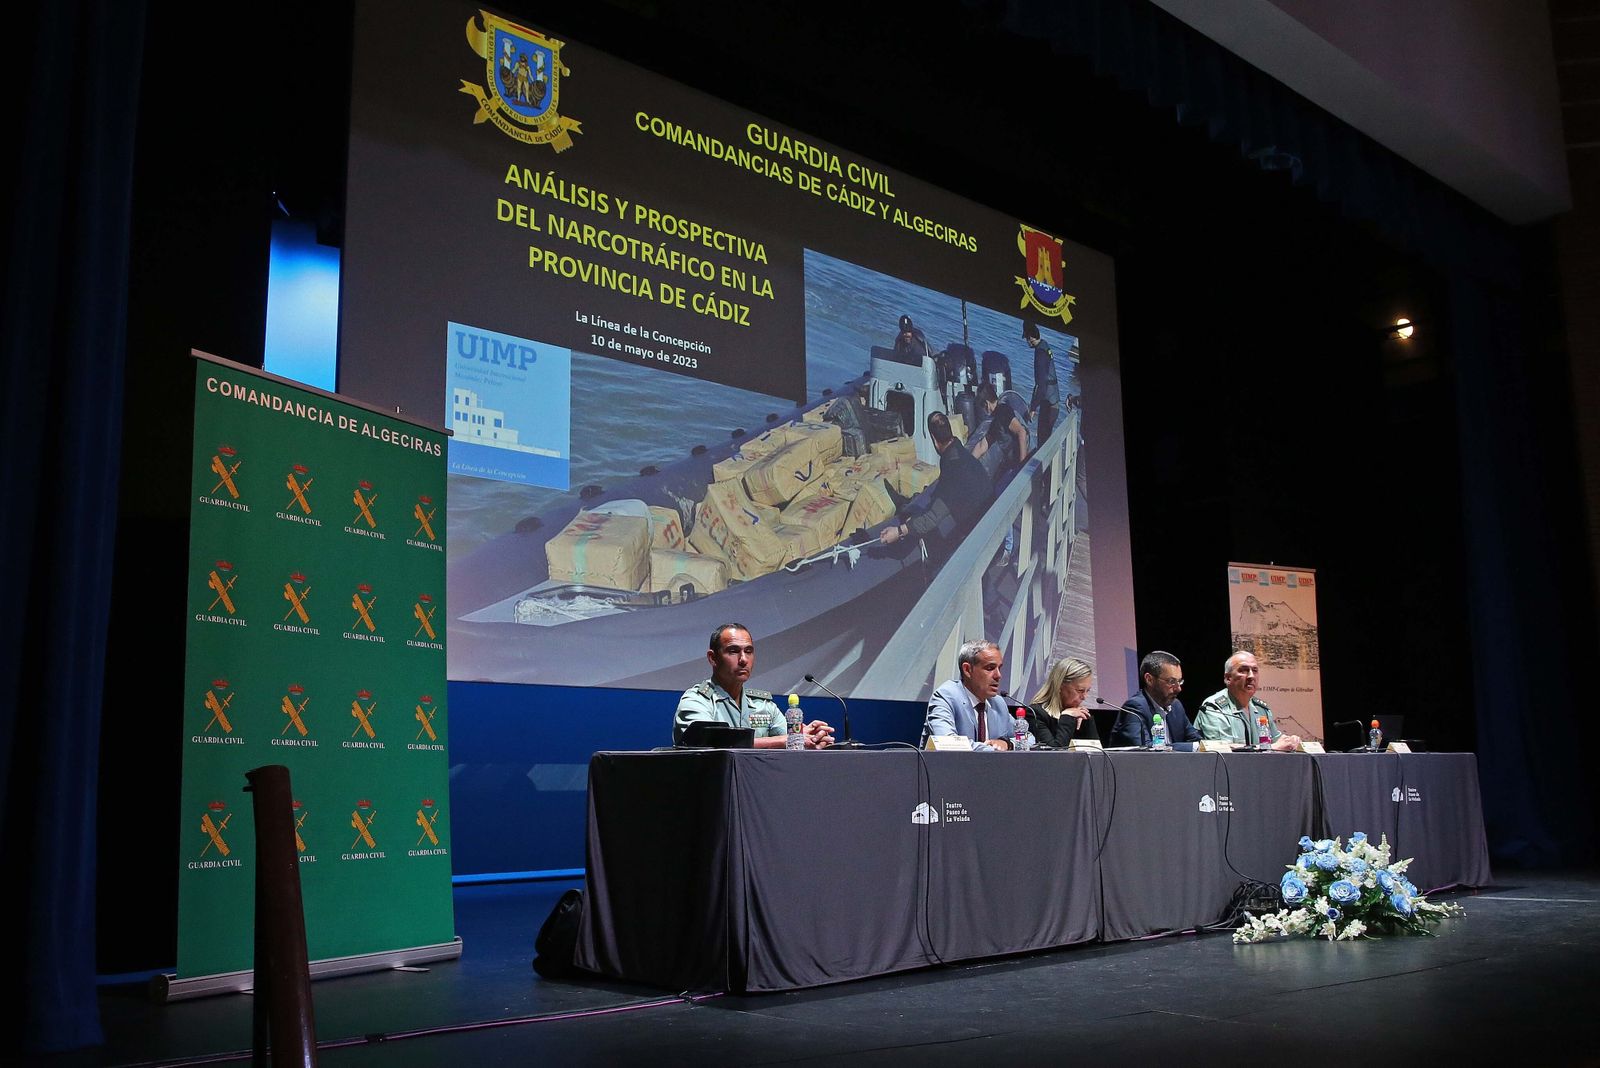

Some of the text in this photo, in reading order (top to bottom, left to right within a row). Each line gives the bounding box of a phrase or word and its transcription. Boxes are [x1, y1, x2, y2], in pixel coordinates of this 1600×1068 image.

[481, 98, 533, 142] COMANDANCIA
[747, 123, 896, 198] GUARDIA CIVIL
[635, 112, 978, 252] COMANDANCIAS DE CÁDIZ Y ALGECIRAS
[505, 164, 768, 265] ANÁLISIS Y PROSPECTIVA
[497, 198, 774, 300] DEL NARCOTRÁFICO EN LA
[529, 246, 750, 326] PROVINCIA DE CÁDIZ
[576, 311, 711, 355] La Línea de la Concepción
[455, 331, 537, 371] UIMP
[591, 334, 698, 369] 10 de mayo de 2023
[206, 377, 442, 457] COMANDANCIA DE ALGECIRAS
[199, 496, 250, 513] GUARDIA CIVIL
[276, 511, 322, 527] GUARDIA CIVIL
[344, 526, 386, 540] GUARDIA CIVIL
[406, 539, 443, 552] GUARDIA CIVIL
[196, 614, 247, 627] GUARDIA CIVIL
[273, 623, 320, 636] GUARDIA CIVIL
[343, 632, 385, 644] GUARDIA CIVIL
[406, 639, 443, 650] GUARDIA CIVIL
[192, 735, 245, 745] GUARDIA CIVIL
[271, 738, 300, 747] GUARDIA
[342, 741, 368, 749] GUARDIA
[407, 743, 431, 751] GUARDIA
[299, 855, 317, 863] CIVIL
[342, 852, 386, 861] GUARDIA CIVIL
[408, 849, 433, 857] GUARDIA
[188, 860, 242, 869] GUARDIA CIVIL
